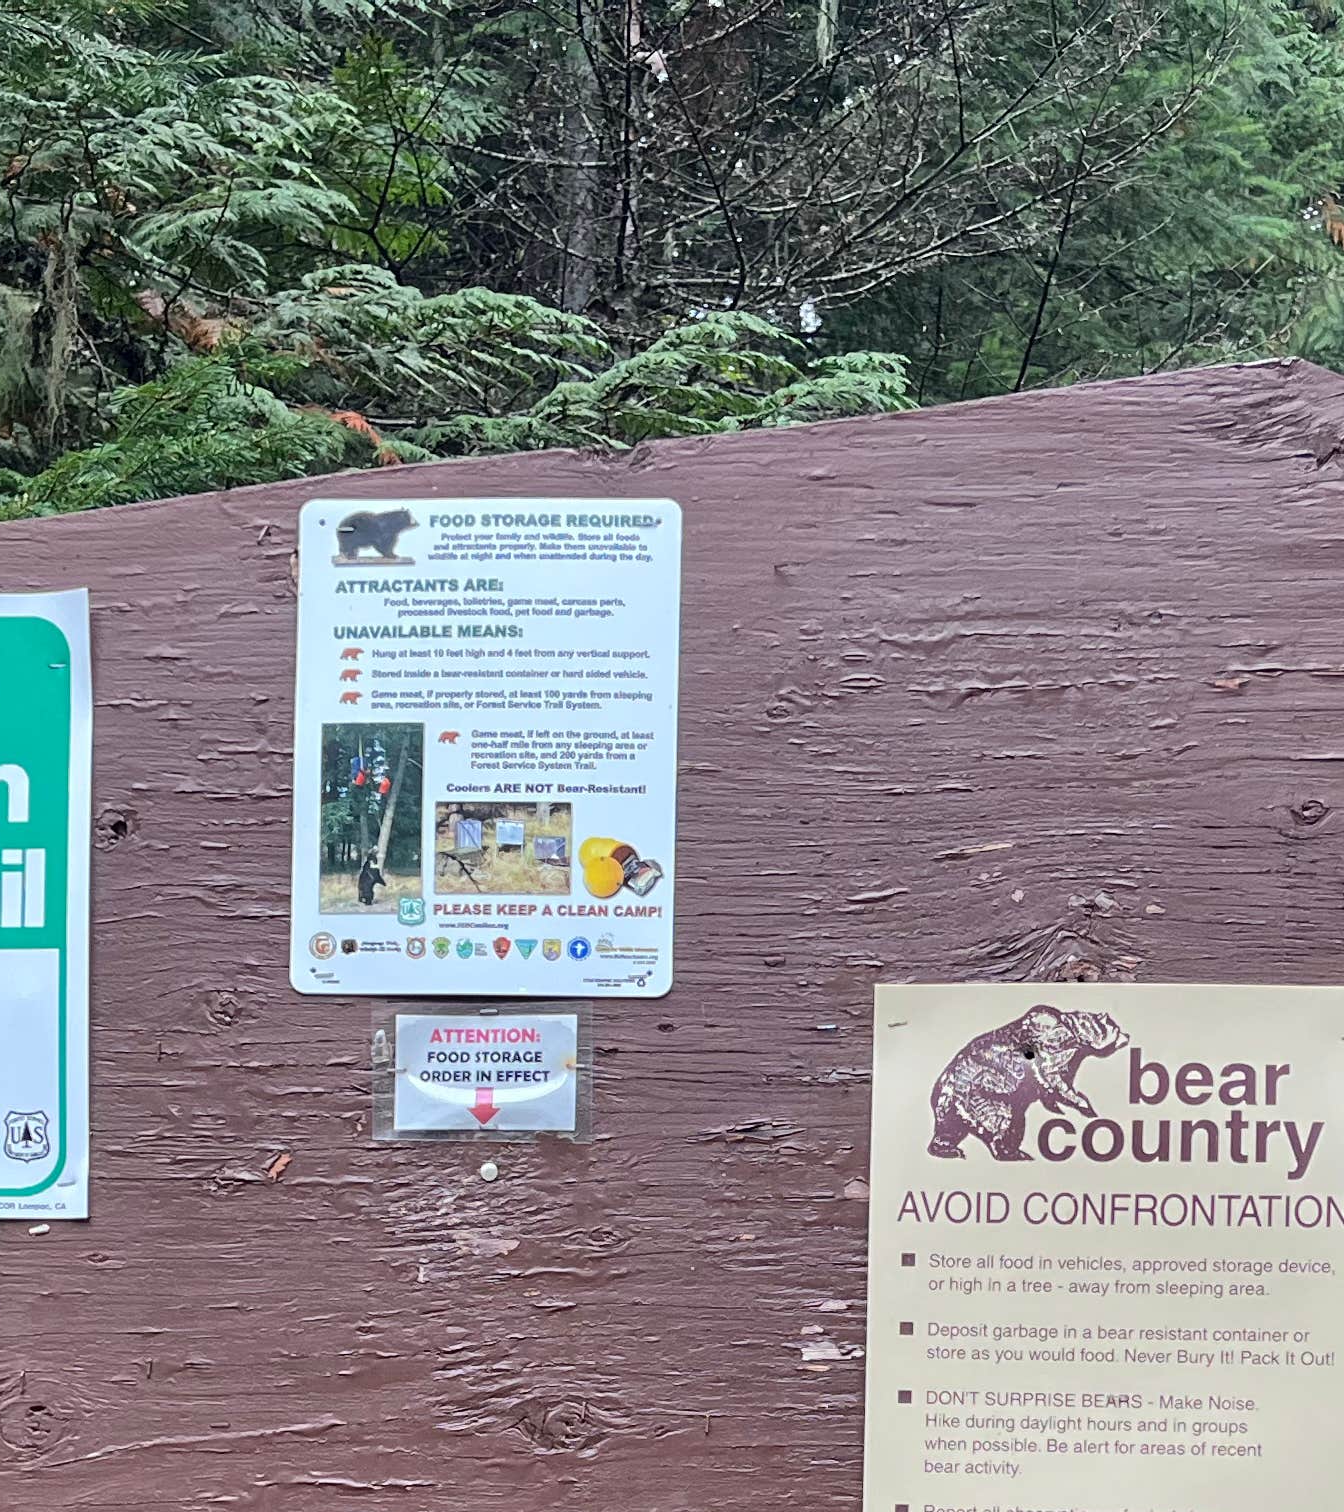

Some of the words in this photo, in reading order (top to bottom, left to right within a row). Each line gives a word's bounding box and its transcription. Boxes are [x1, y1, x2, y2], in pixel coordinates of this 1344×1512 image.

[429, 514, 476, 528] FOOD
[480, 513, 561, 527] STORAGE
[334, 578, 459, 593] ATTRACTANTS
[463, 578, 503, 592] ARE:
[333, 624, 452, 639] UNAVAILABLE
[457, 624, 523, 638] MEANS:
[446, 783, 491, 792] Coolers
[493, 783, 521, 793] ARE
[524, 783, 553, 793] NOT
[433, 903, 492, 915] PLEASE
[496, 903, 537, 916] KEEP
[541, 904, 553, 916] A
[556, 904, 608, 917] CLEAN
[613, 905, 662, 918] CAMP!
[429, 1027, 540, 1043] ATTENTION:
[427, 1051, 470, 1063] FOOD
[475, 1050, 542, 1063] STORAGE
[419, 1070, 471, 1082] ORDER
[476, 1070, 491, 1082] IN
[496, 1070, 550, 1082] EFFECT
[1128, 1047, 1290, 1106] bear
[1037, 1109, 1324, 1180] country
[896, 1190, 1009, 1223] AVOID
[929, 1253, 971, 1268] Store
[976, 1254, 994, 1268] all
[999, 1254, 1033, 1269] food
[1038, 1256, 1052, 1269] in
[1057, 1255, 1126, 1273] vehicles,
[1131, 1257, 1207, 1274] approved
[1212, 1258, 1272, 1276] storage
[928, 1279, 945, 1290] or
[949, 1276, 982, 1295] high
[1006, 1280, 1016, 1292] a
[1021, 1279, 1052, 1292] tree
[1068, 1281, 1109, 1297] away
[1114, 1279, 1150, 1294] from
[1155, 1280, 1223, 1299] sleeping
[927, 1322, 988, 1340] Deposit
[992, 1323, 1058, 1342] garbage
[1063, 1324, 1076, 1339] in
[1081, 1327, 1092, 1339] a
[1097, 1324, 1134, 1339] bear
[1139, 1326, 1207, 1341] resistant
[1212, 1327, 1289, 1342] container
[1293, 1331, 1310, 1343] or
[926, 1345, 966, 1360] store
[971, 1348, 990, 1360] as
[994, 1349, 1023, 1364] you
[1028, 1347, 1075, 1362] would
[1124, 1348, 1172, 1363] Never
[1176, 1349, 1215, 1367] Bury
[1220, 1350, 1234, 1364] It!
[1240, 1350, 1280, 1365] Pack
[1285, 1351, 1295, 1365] It
[1300, 1350, 1335, 1366] Out!
[926, 1390, 980, 1405] DON'T
[984, 1391, 1076, 1407] SURPRISE
[1081, 1393, 1142, 1409] BEARS
[1159, 1394, 1203, 1409] Make
[925, 1413, 960, 1428] Hike
[965, 1414, 1015, 1433] during
[1019, 1415, 1082, 1434] daylight
[1087, 1416, 1132, 1431] hours
[1136, 1418, 1167, 1432] and
[1173, 1420, 1186, 1432] in
[1191, 1421, 1248, 1437] groups
[924, 1436, 967, 1451] when
[972, 1437, 1041, 1454] possible.
[1046, 1438, 1068, 1453] Be
[1073, 1439, 1109, 1454] alert
[1113, 1439, 1136, 1454] for
[1139, 1443, 1185, 1455] areas
[1190, 1441, 1206, 1455] of
[1211, 1443, 1262, 1457] recent
[924, 1459, 960, 1473] bear
[964, 1460, 1022, 1478] activity.
